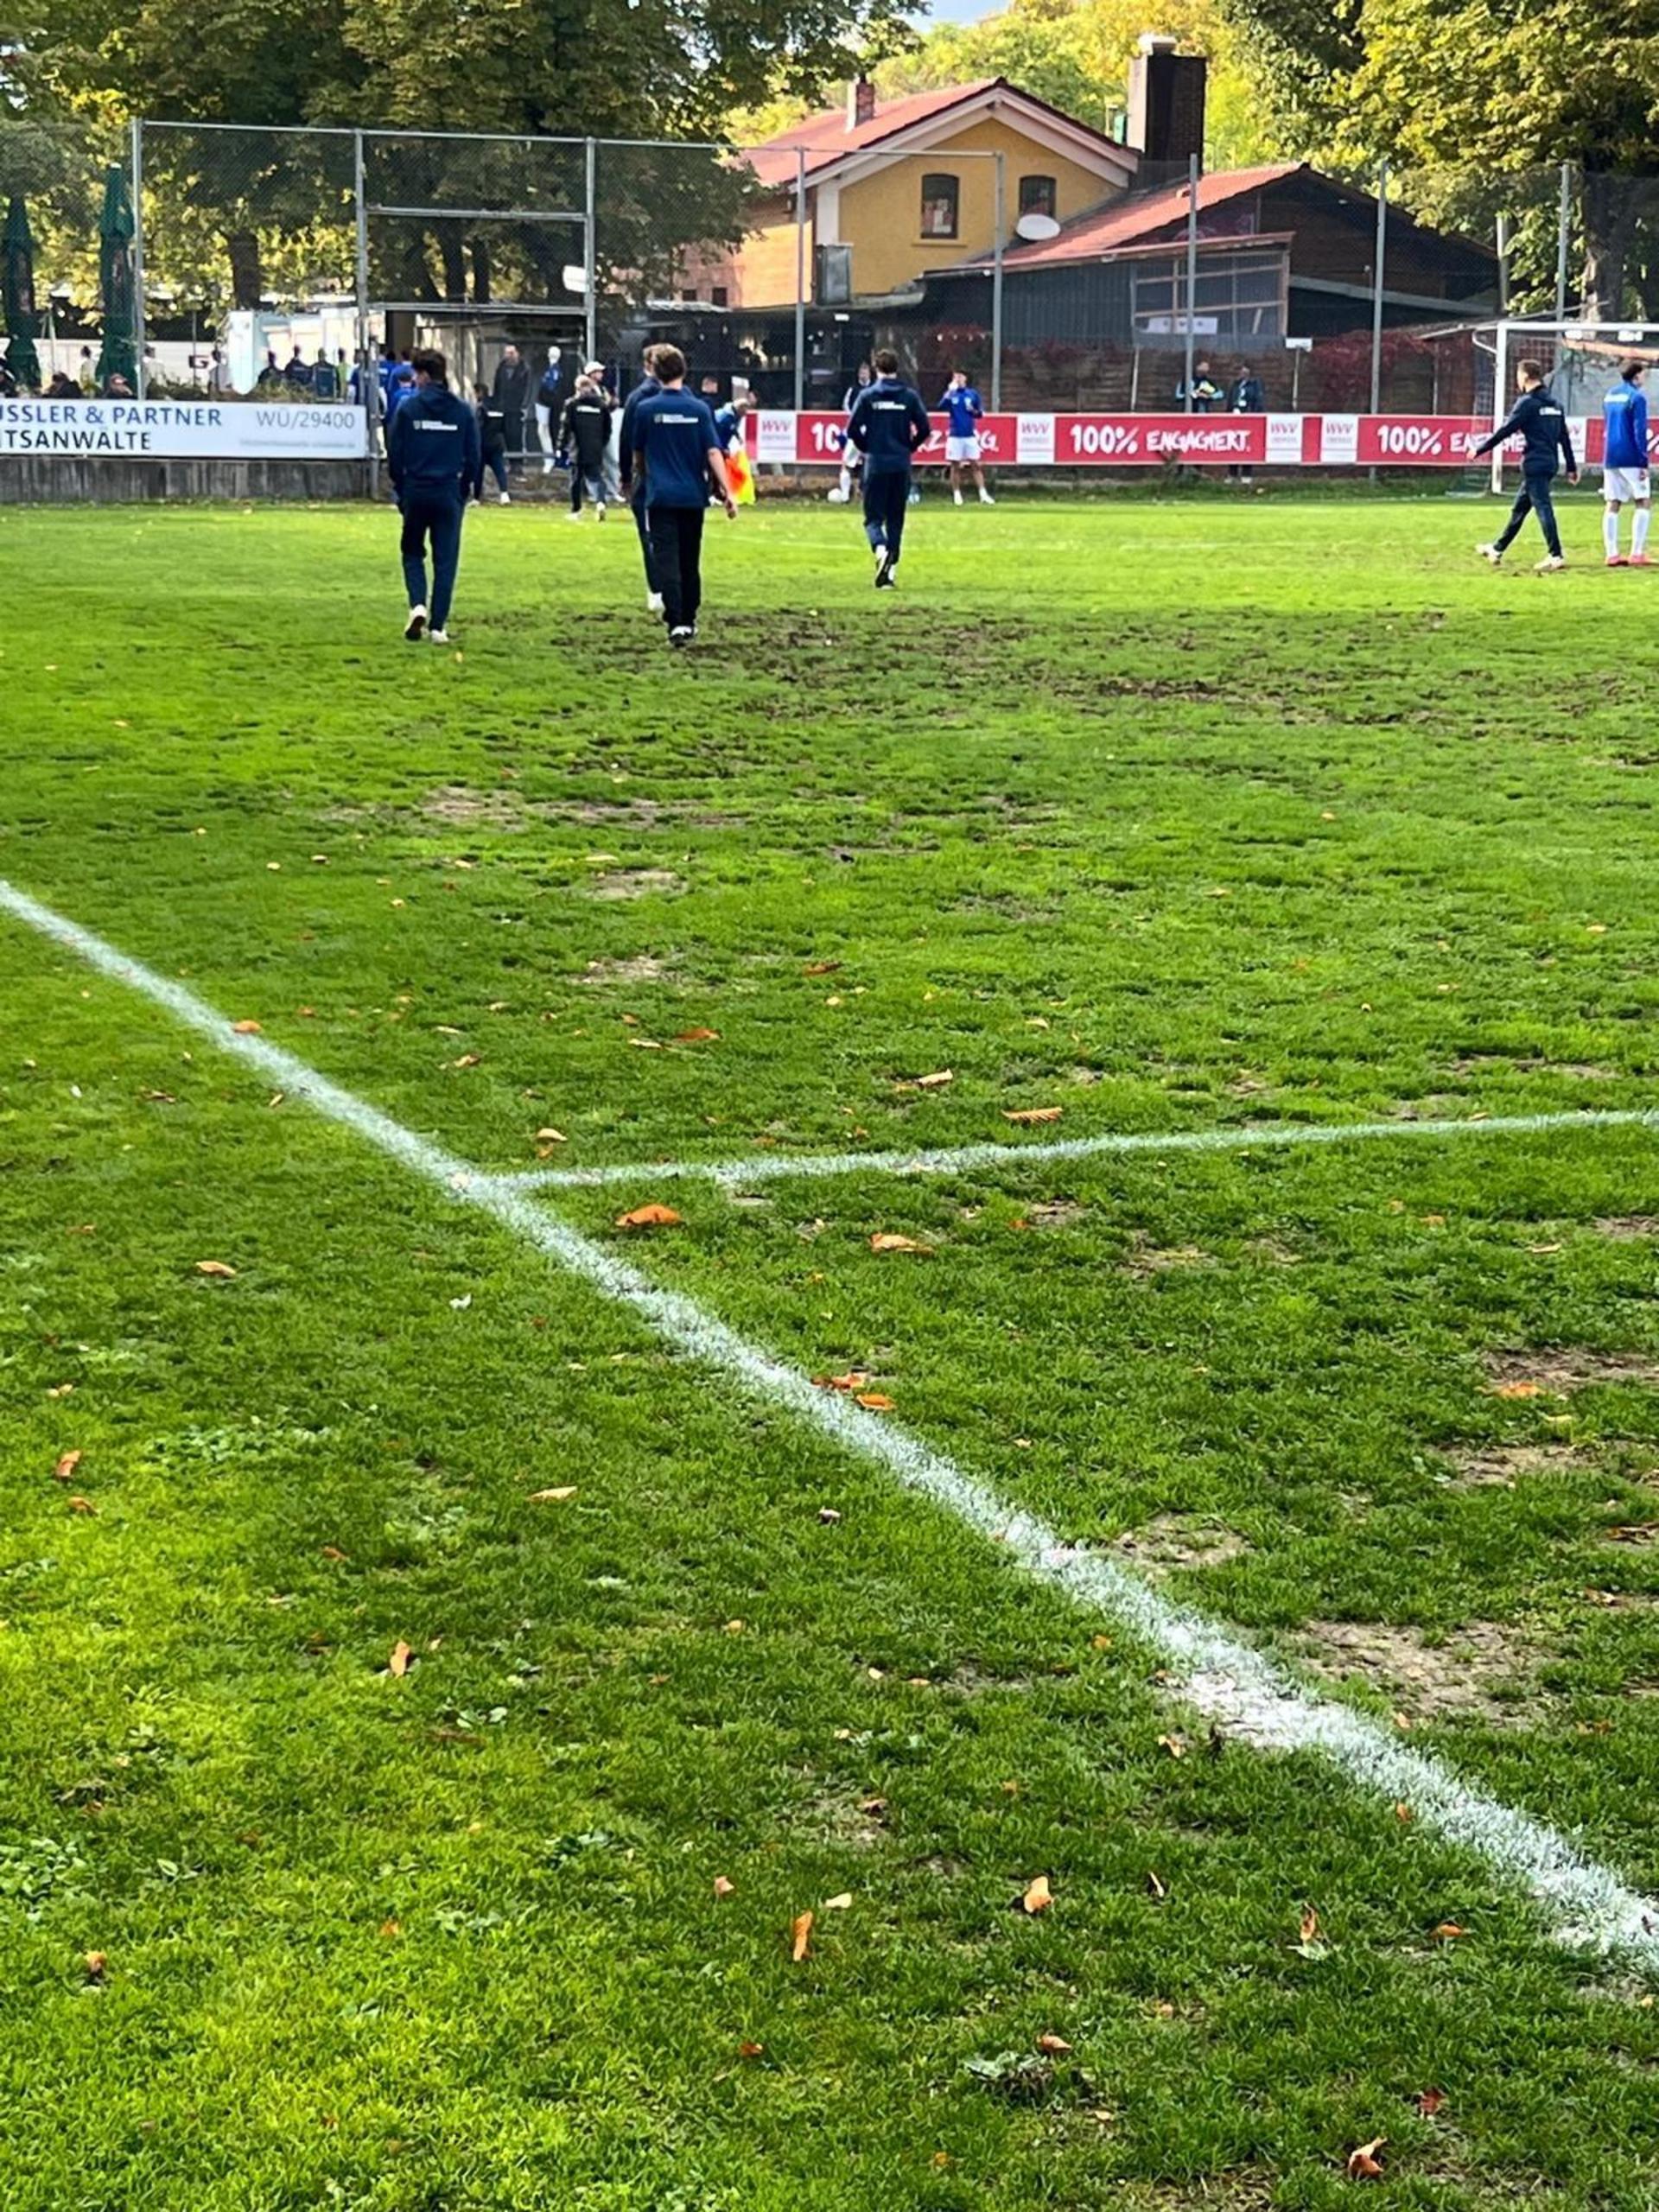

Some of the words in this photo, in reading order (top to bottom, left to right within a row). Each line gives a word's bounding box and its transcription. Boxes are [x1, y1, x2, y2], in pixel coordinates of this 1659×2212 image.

[85, 405, 105, 424] &
[111, 406, 222, 427] PARTNER
[256, 407, 356, 429] WÜ/29400
[0, 426, 152, 450] TSANWÄLTE
[1070, 423, 1140, 454] 100%
[1376, 424, 1444, 455] 100%
